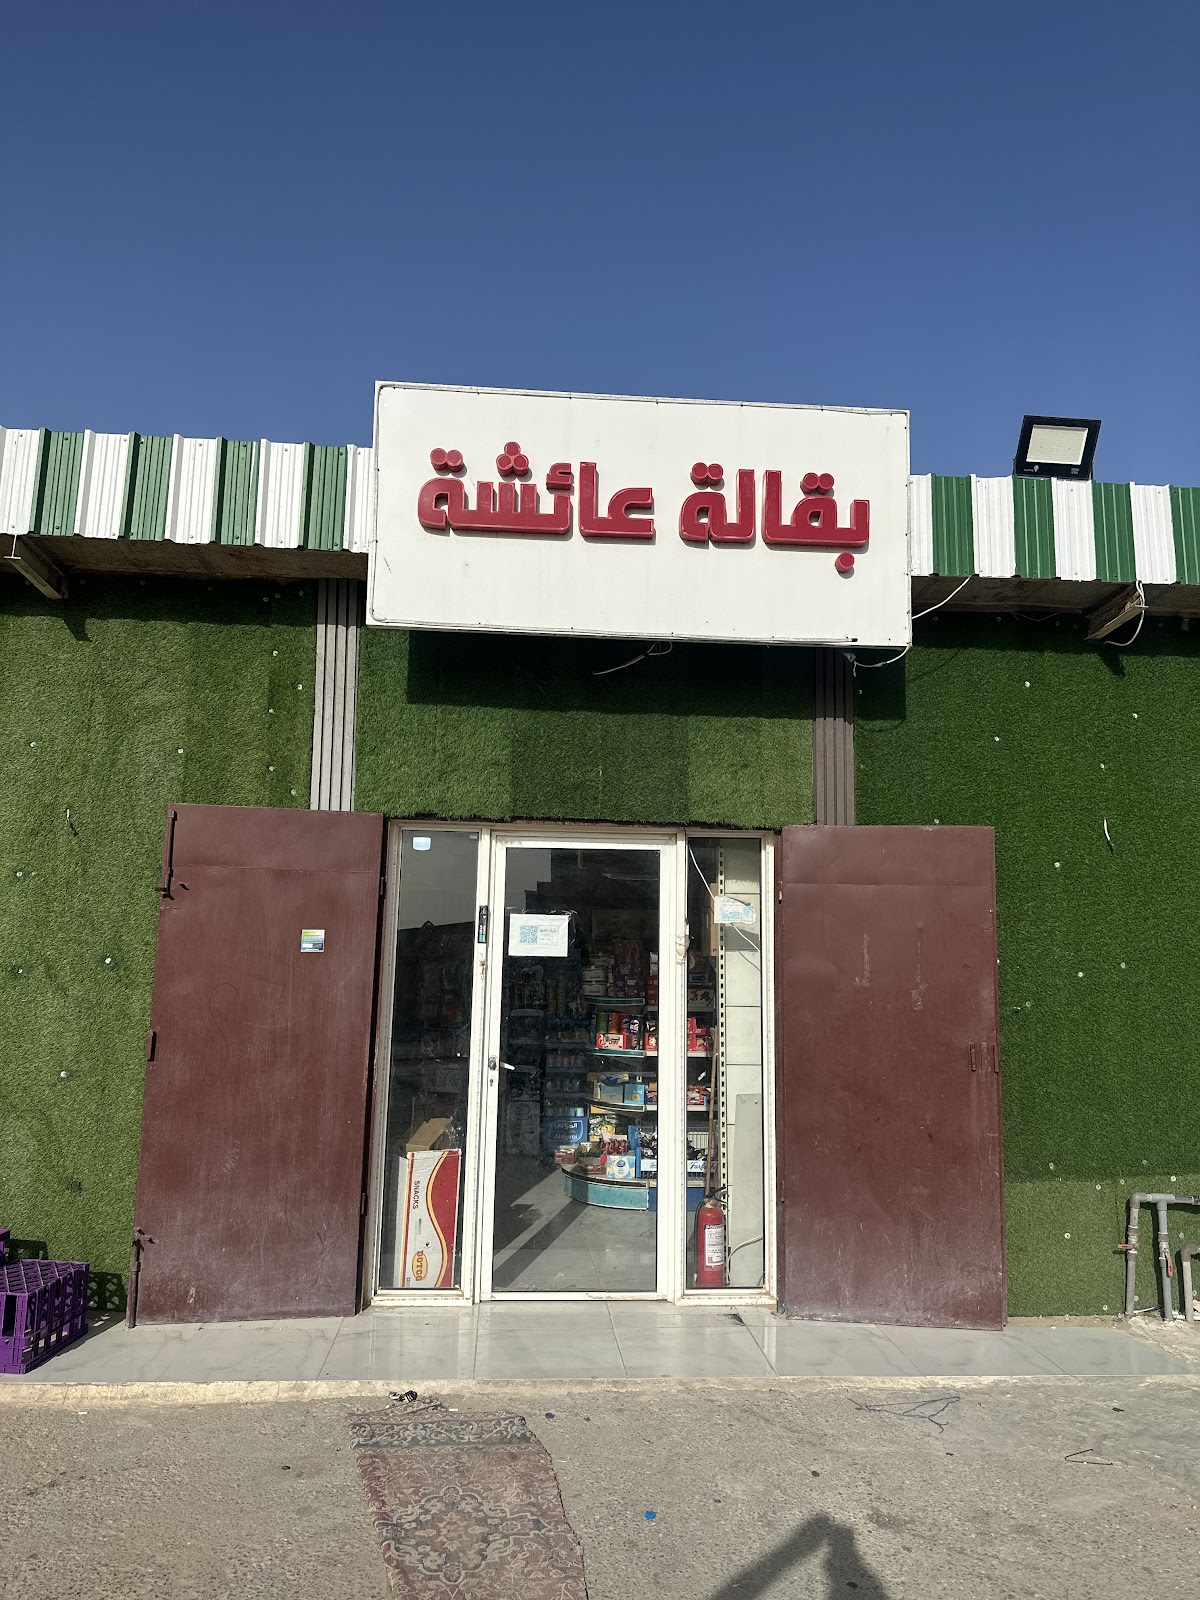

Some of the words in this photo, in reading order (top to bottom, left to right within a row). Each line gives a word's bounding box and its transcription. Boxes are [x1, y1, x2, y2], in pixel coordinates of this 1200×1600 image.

[418, 442, 654, 537] عائشة
[680, 463, 870, 570] بقالة
[412, 1180, 421, 1210] SNACKS
